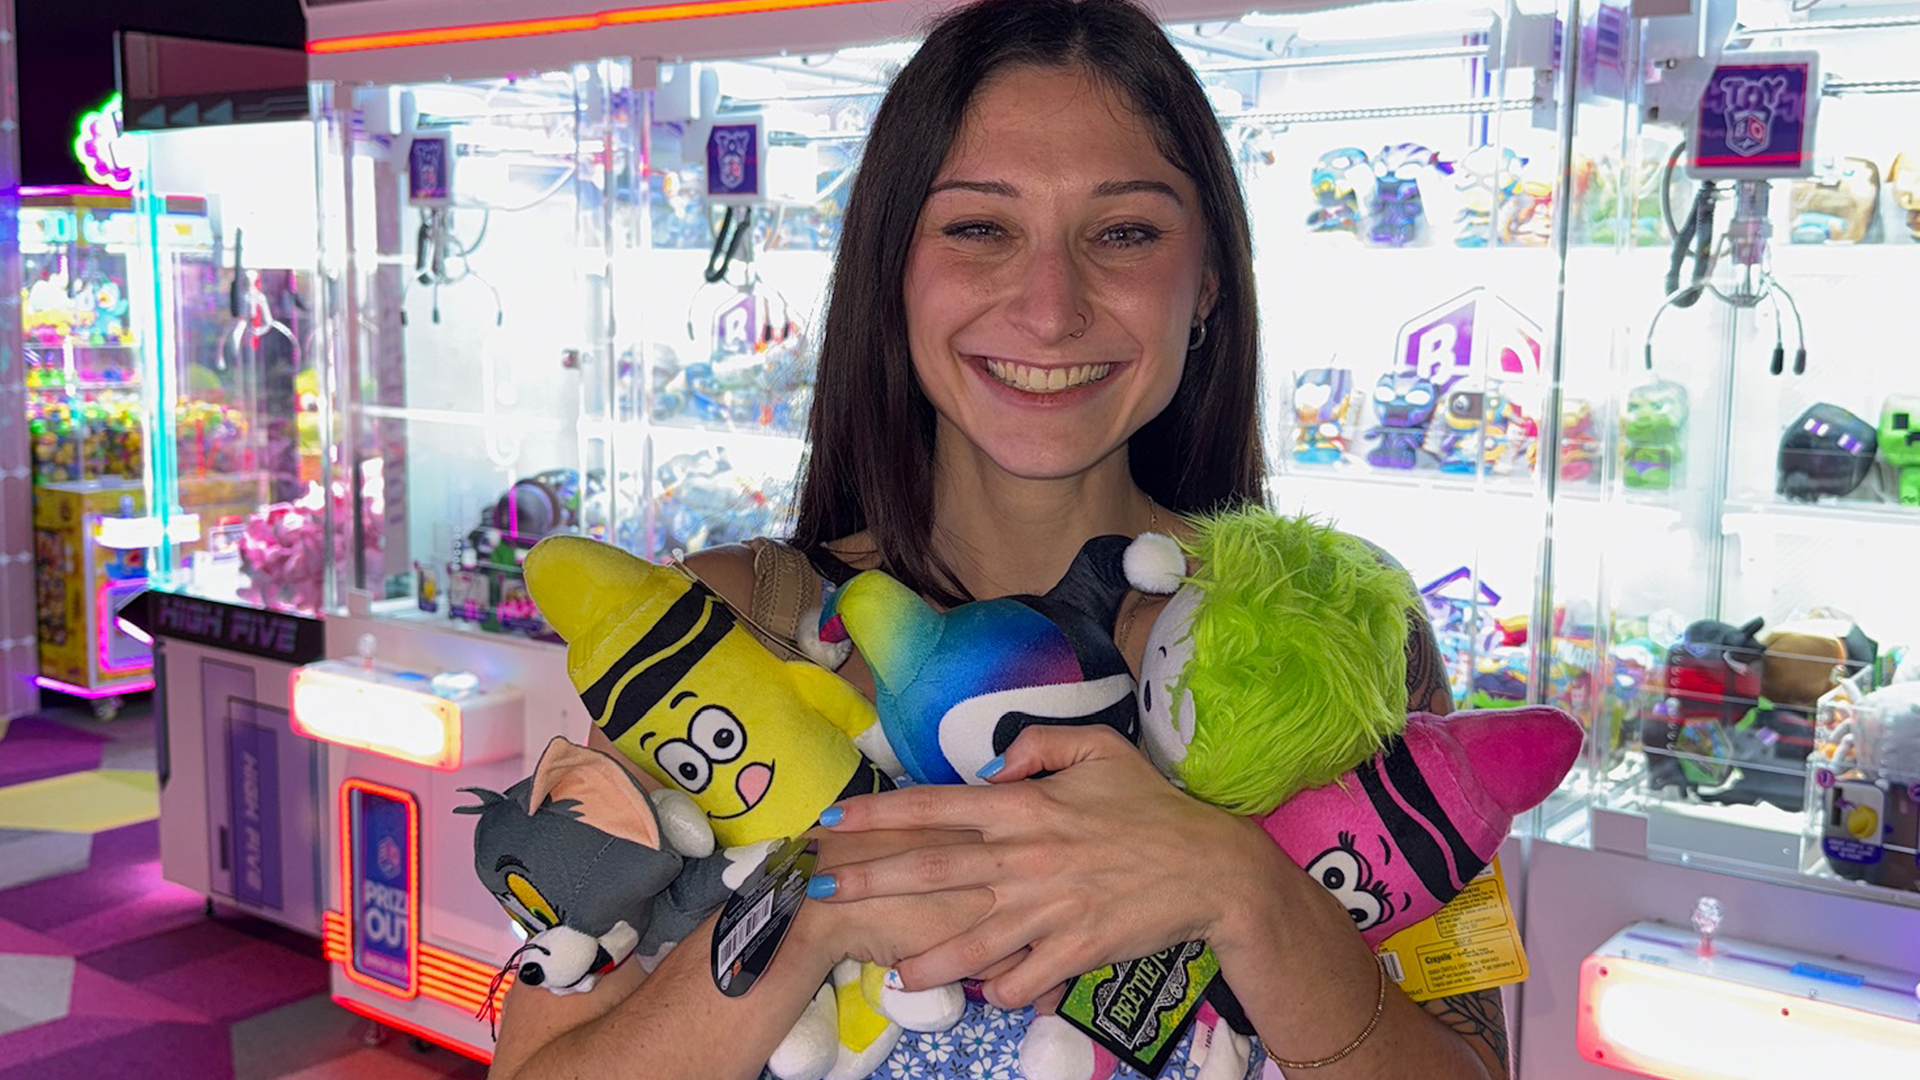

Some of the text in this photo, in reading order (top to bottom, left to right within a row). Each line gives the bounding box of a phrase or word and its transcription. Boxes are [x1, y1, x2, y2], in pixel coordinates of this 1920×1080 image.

[1721, 76, 1787, 109] TOY
[159, 600, 297, 653] HIGH FIVE
[1109, 947, 1176, 1028] BEETLEJU
